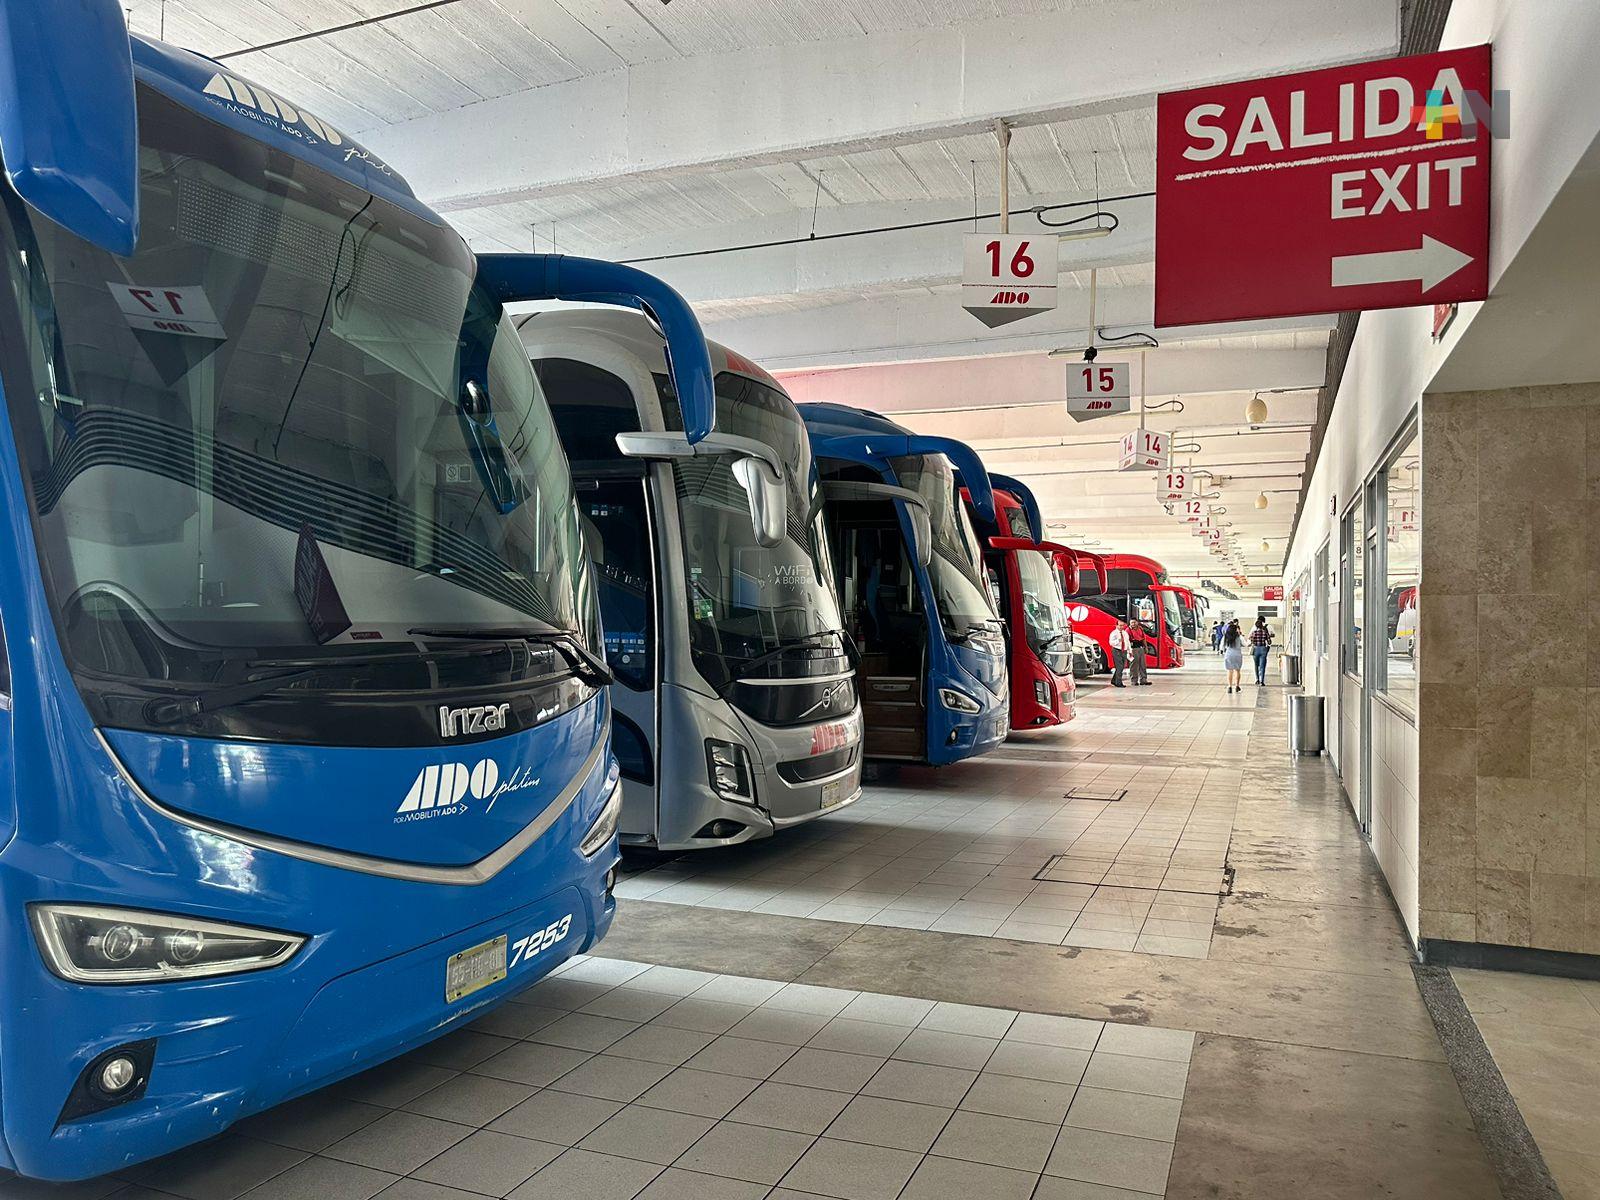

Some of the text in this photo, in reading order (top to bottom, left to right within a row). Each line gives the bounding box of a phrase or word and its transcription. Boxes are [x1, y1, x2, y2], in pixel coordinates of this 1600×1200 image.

[203, 72, 342, 146] ADO
[226, 103, 278, 128] MOBILITY
[280, 123, 303, 138] ADO
[1182, 67, 1477, 162] SALIDA
[1331, 156, 1477, 220] EXIT
[986, 240, 1035, 278] 16
[990, 291, 1030, 305] ADO
[1082, 367, 1115, 392] 15
[1086, 400, 1113, 410] ADO
[1145, 433, 1161, 454] 14
[1166, 474, 1185, 489] 13
[1186, 501, 1201, 513] 12
[396, 758, 499, 813] ADO
[404, 808, 441, 822] MOBILITY
[441, 806, 458, 816] ADO
[508, 913, 573, 969] 7253
